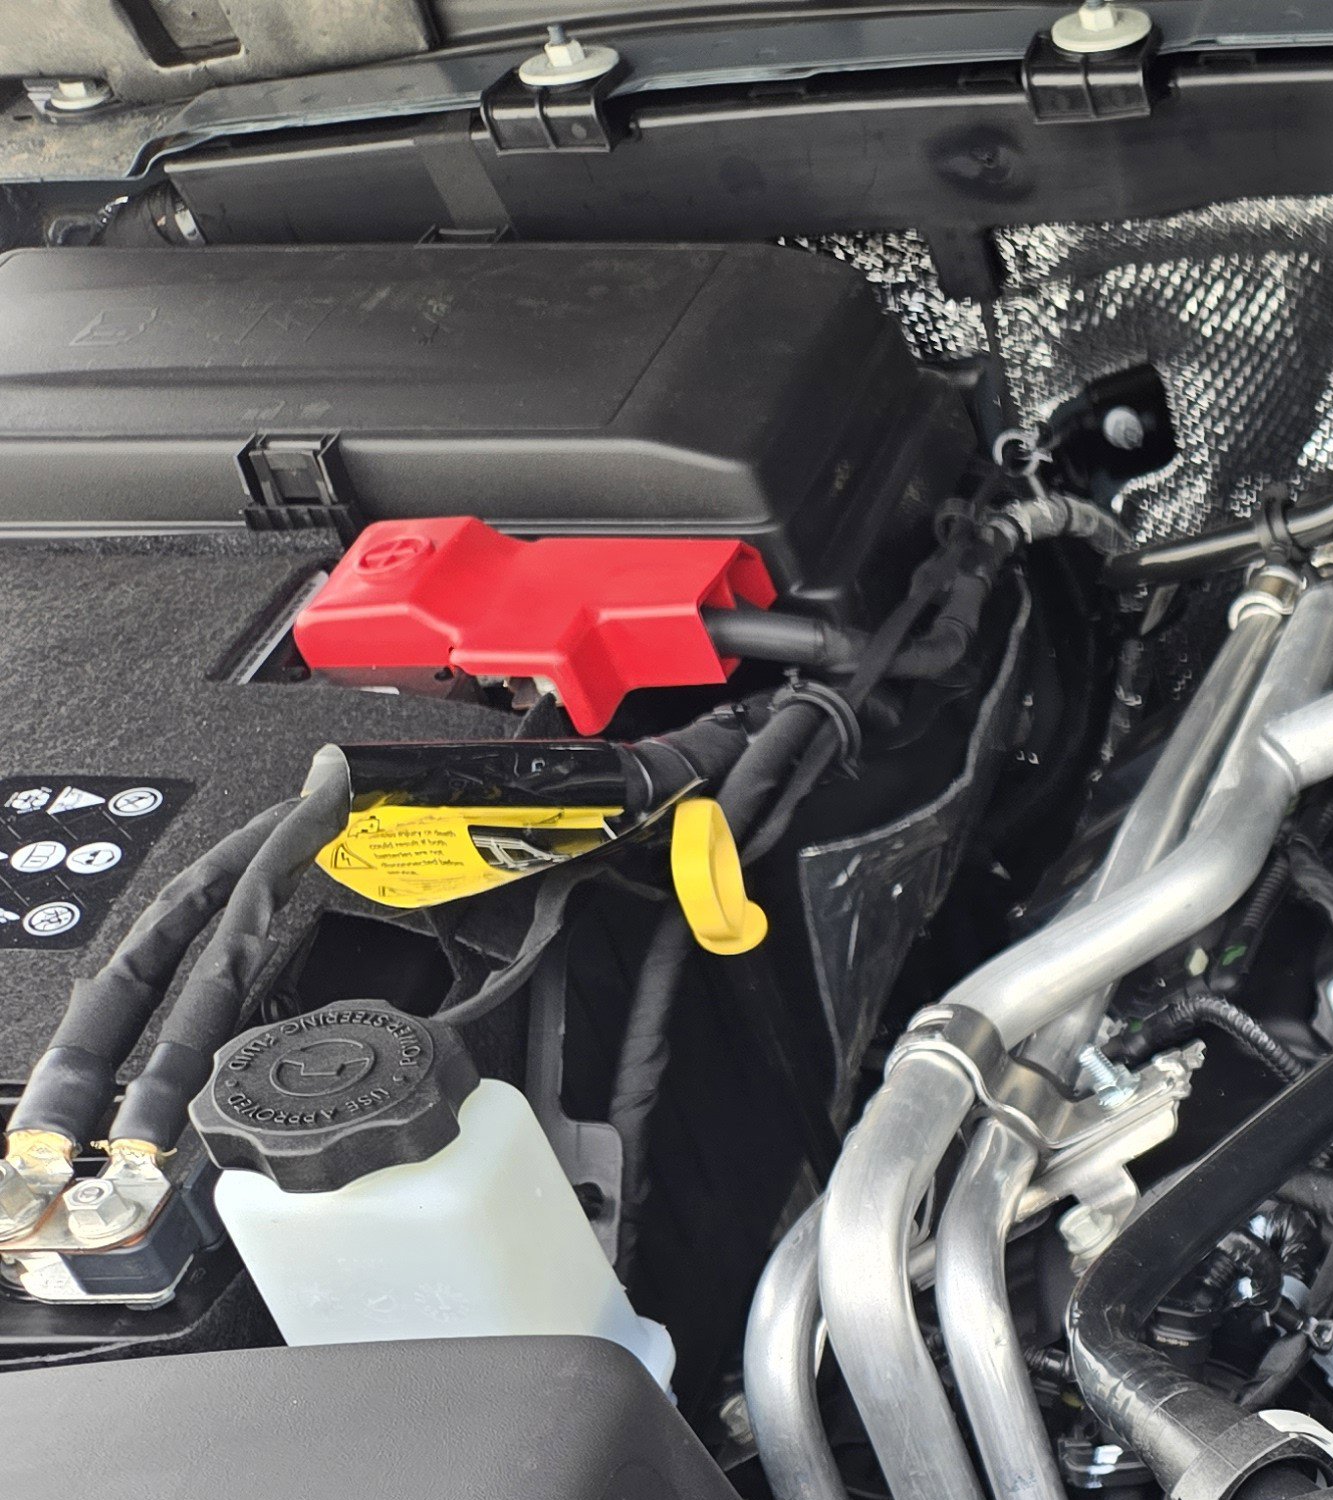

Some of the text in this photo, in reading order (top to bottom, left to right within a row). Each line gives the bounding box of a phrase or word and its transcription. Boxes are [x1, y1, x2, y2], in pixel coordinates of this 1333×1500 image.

[228, 1010, 421, 1071] POWER STEERING FLUID
[227, 1087, 391, 1125] USE APPROVED
